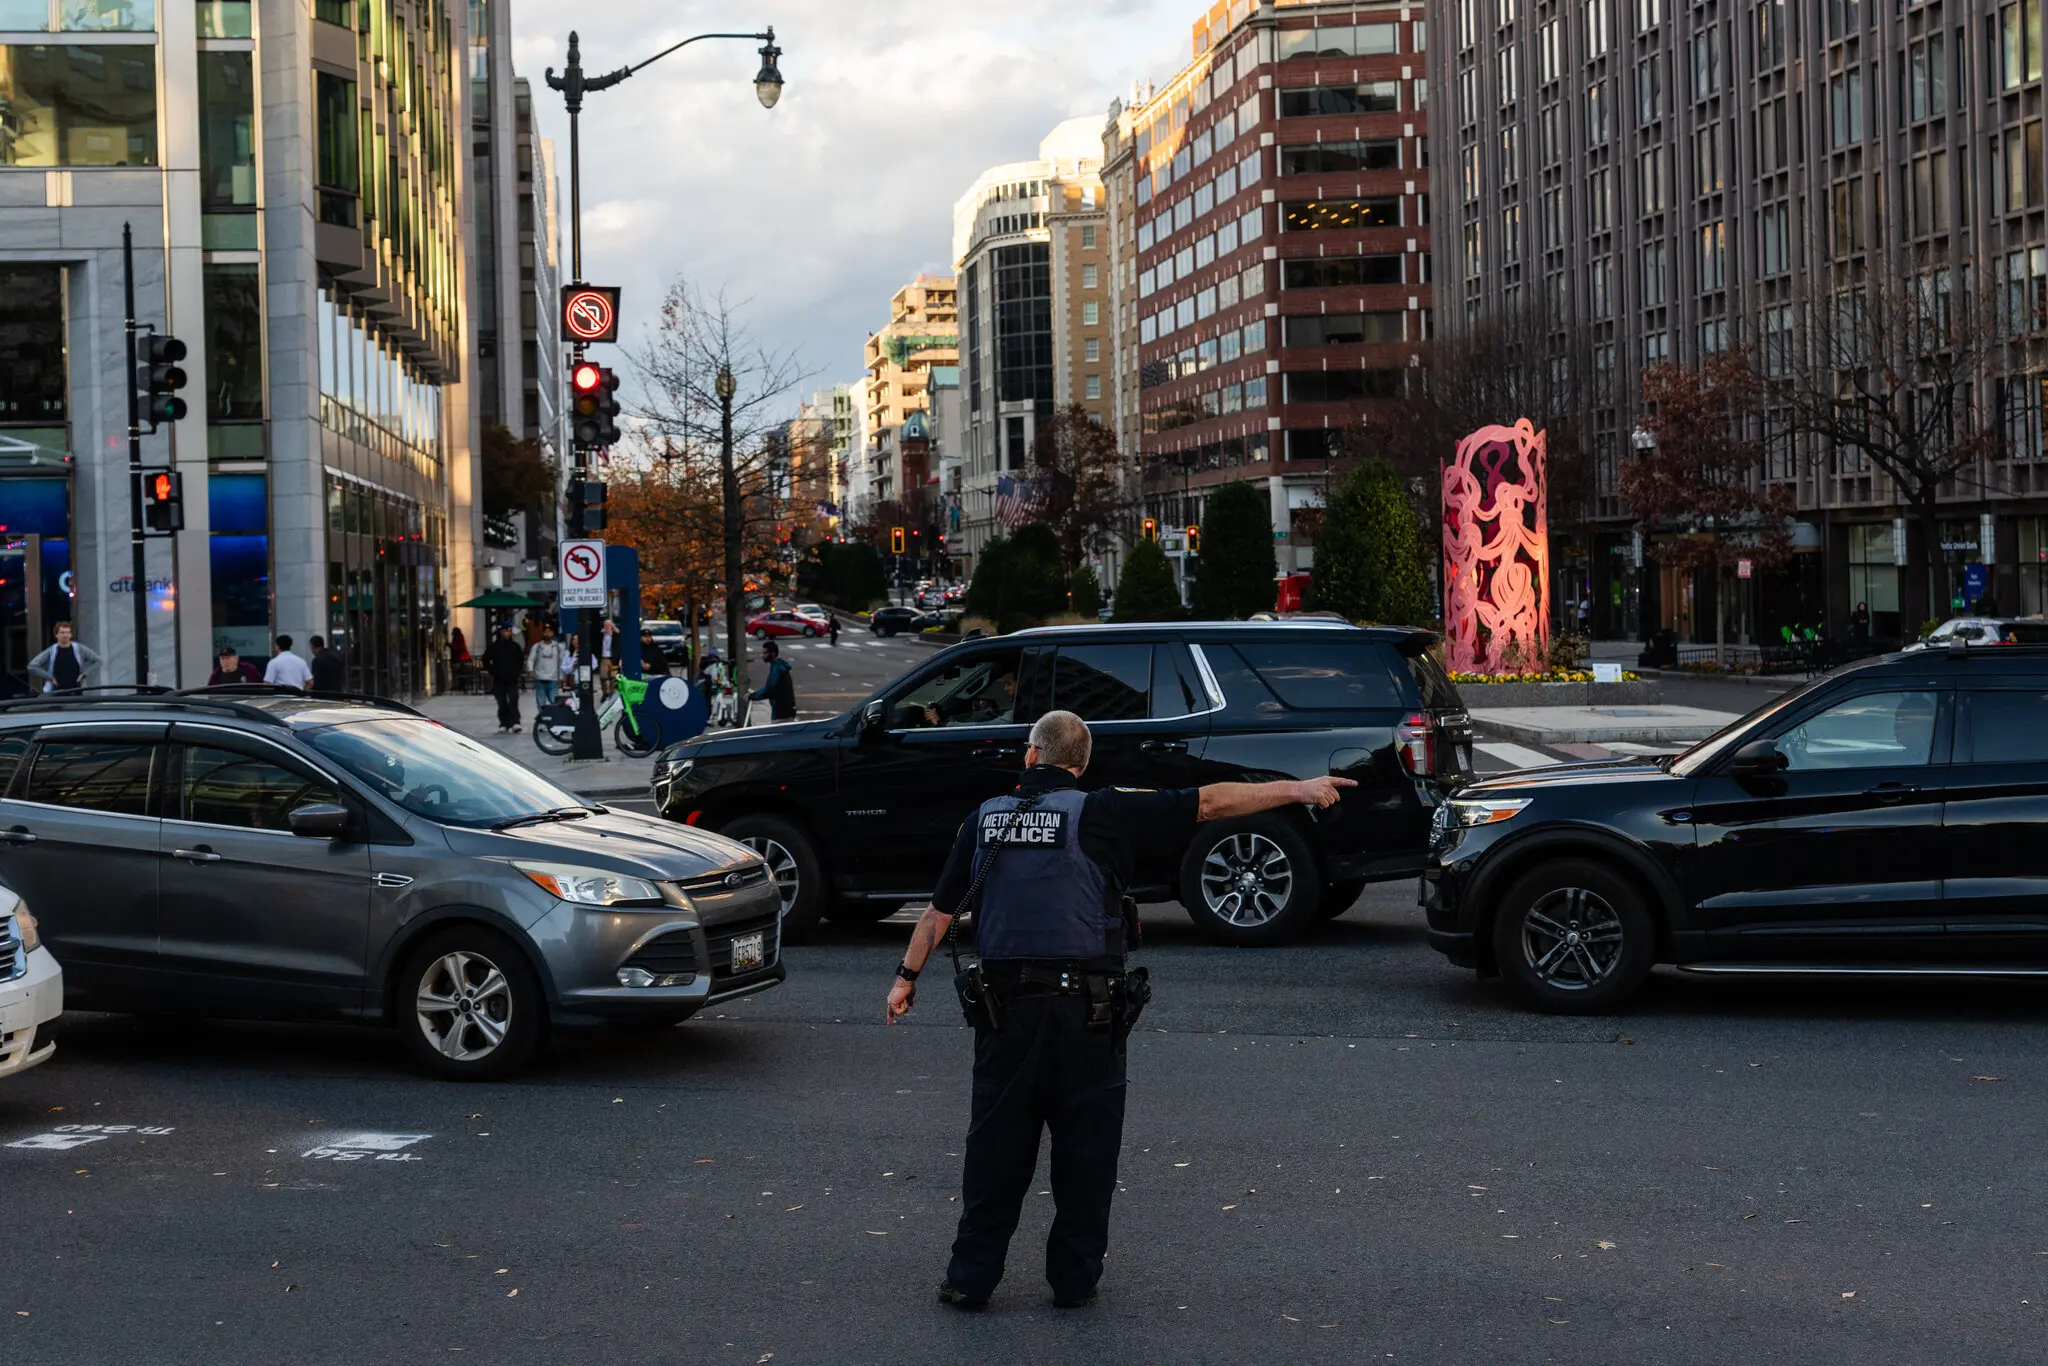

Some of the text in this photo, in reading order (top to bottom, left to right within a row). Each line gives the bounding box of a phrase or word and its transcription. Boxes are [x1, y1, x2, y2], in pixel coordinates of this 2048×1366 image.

[1966, 541, 1978, 549] Bank
[109, 577, 171, 593] citiank
[983, 812, 1060, 828] METROPOLITAN
[984, 827, 1056, 843] POLICE
